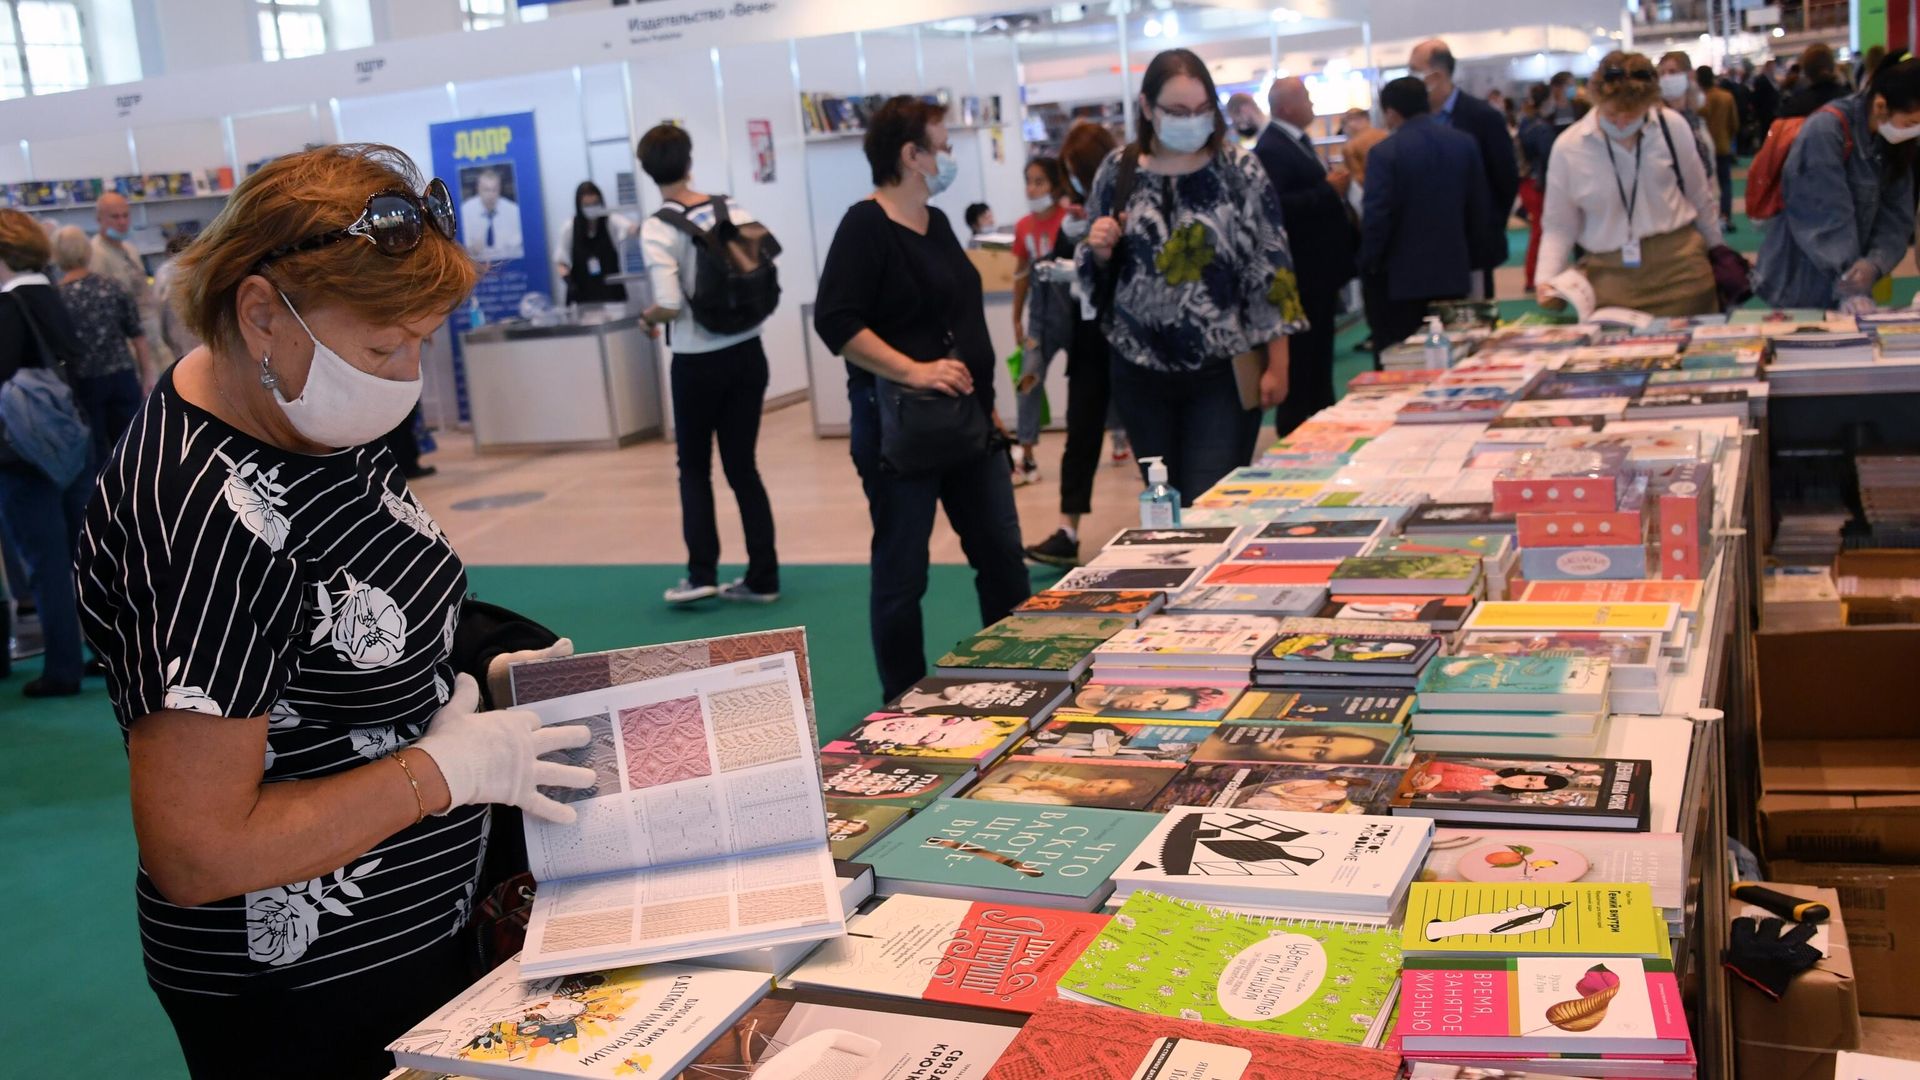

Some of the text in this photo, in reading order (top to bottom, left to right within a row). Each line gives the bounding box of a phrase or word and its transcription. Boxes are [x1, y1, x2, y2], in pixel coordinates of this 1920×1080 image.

[629, 8, 725, 31] Издательство
[454, 126, 512, 160] ЛДПР
[919, 819, 979, 850] ВРЫ
[994, 811, 1067, 857] ВАЮТ
[1344, 824, 1378, 861] РИСОВАНИЕ
[1365, 824, 1393, 854] ПРОСТОЕ
[1018, 825, 1090, 881] СКРЫ-
[1057, 842, 1116, 878] ЧТО
[1608, 890, 1621, 908] Гений
[1607, 909, 1620, 933] внутри
[960, 910, 1044, 994] ЛЕТТЕРИНГ
[1264, 954, 1280, 964] по
[1279, 943, 1312, 973] Цветы
[1242, 966, 1274, 1000] линиям
[1254, 984, 1285, 1016] листья
[1472, 973, 1493, 1018] ВРЕМЯ,
[1412, 972, 1434, 1032] ЖИЗНЬЮ
[1442, 972, 1464, 1033] ЗАНЯТОЕ
[578, 1013, 664, 1067] ИЛЛЮСТРАЦИИ
[633, 1027, 668, 1048] КНИГА
